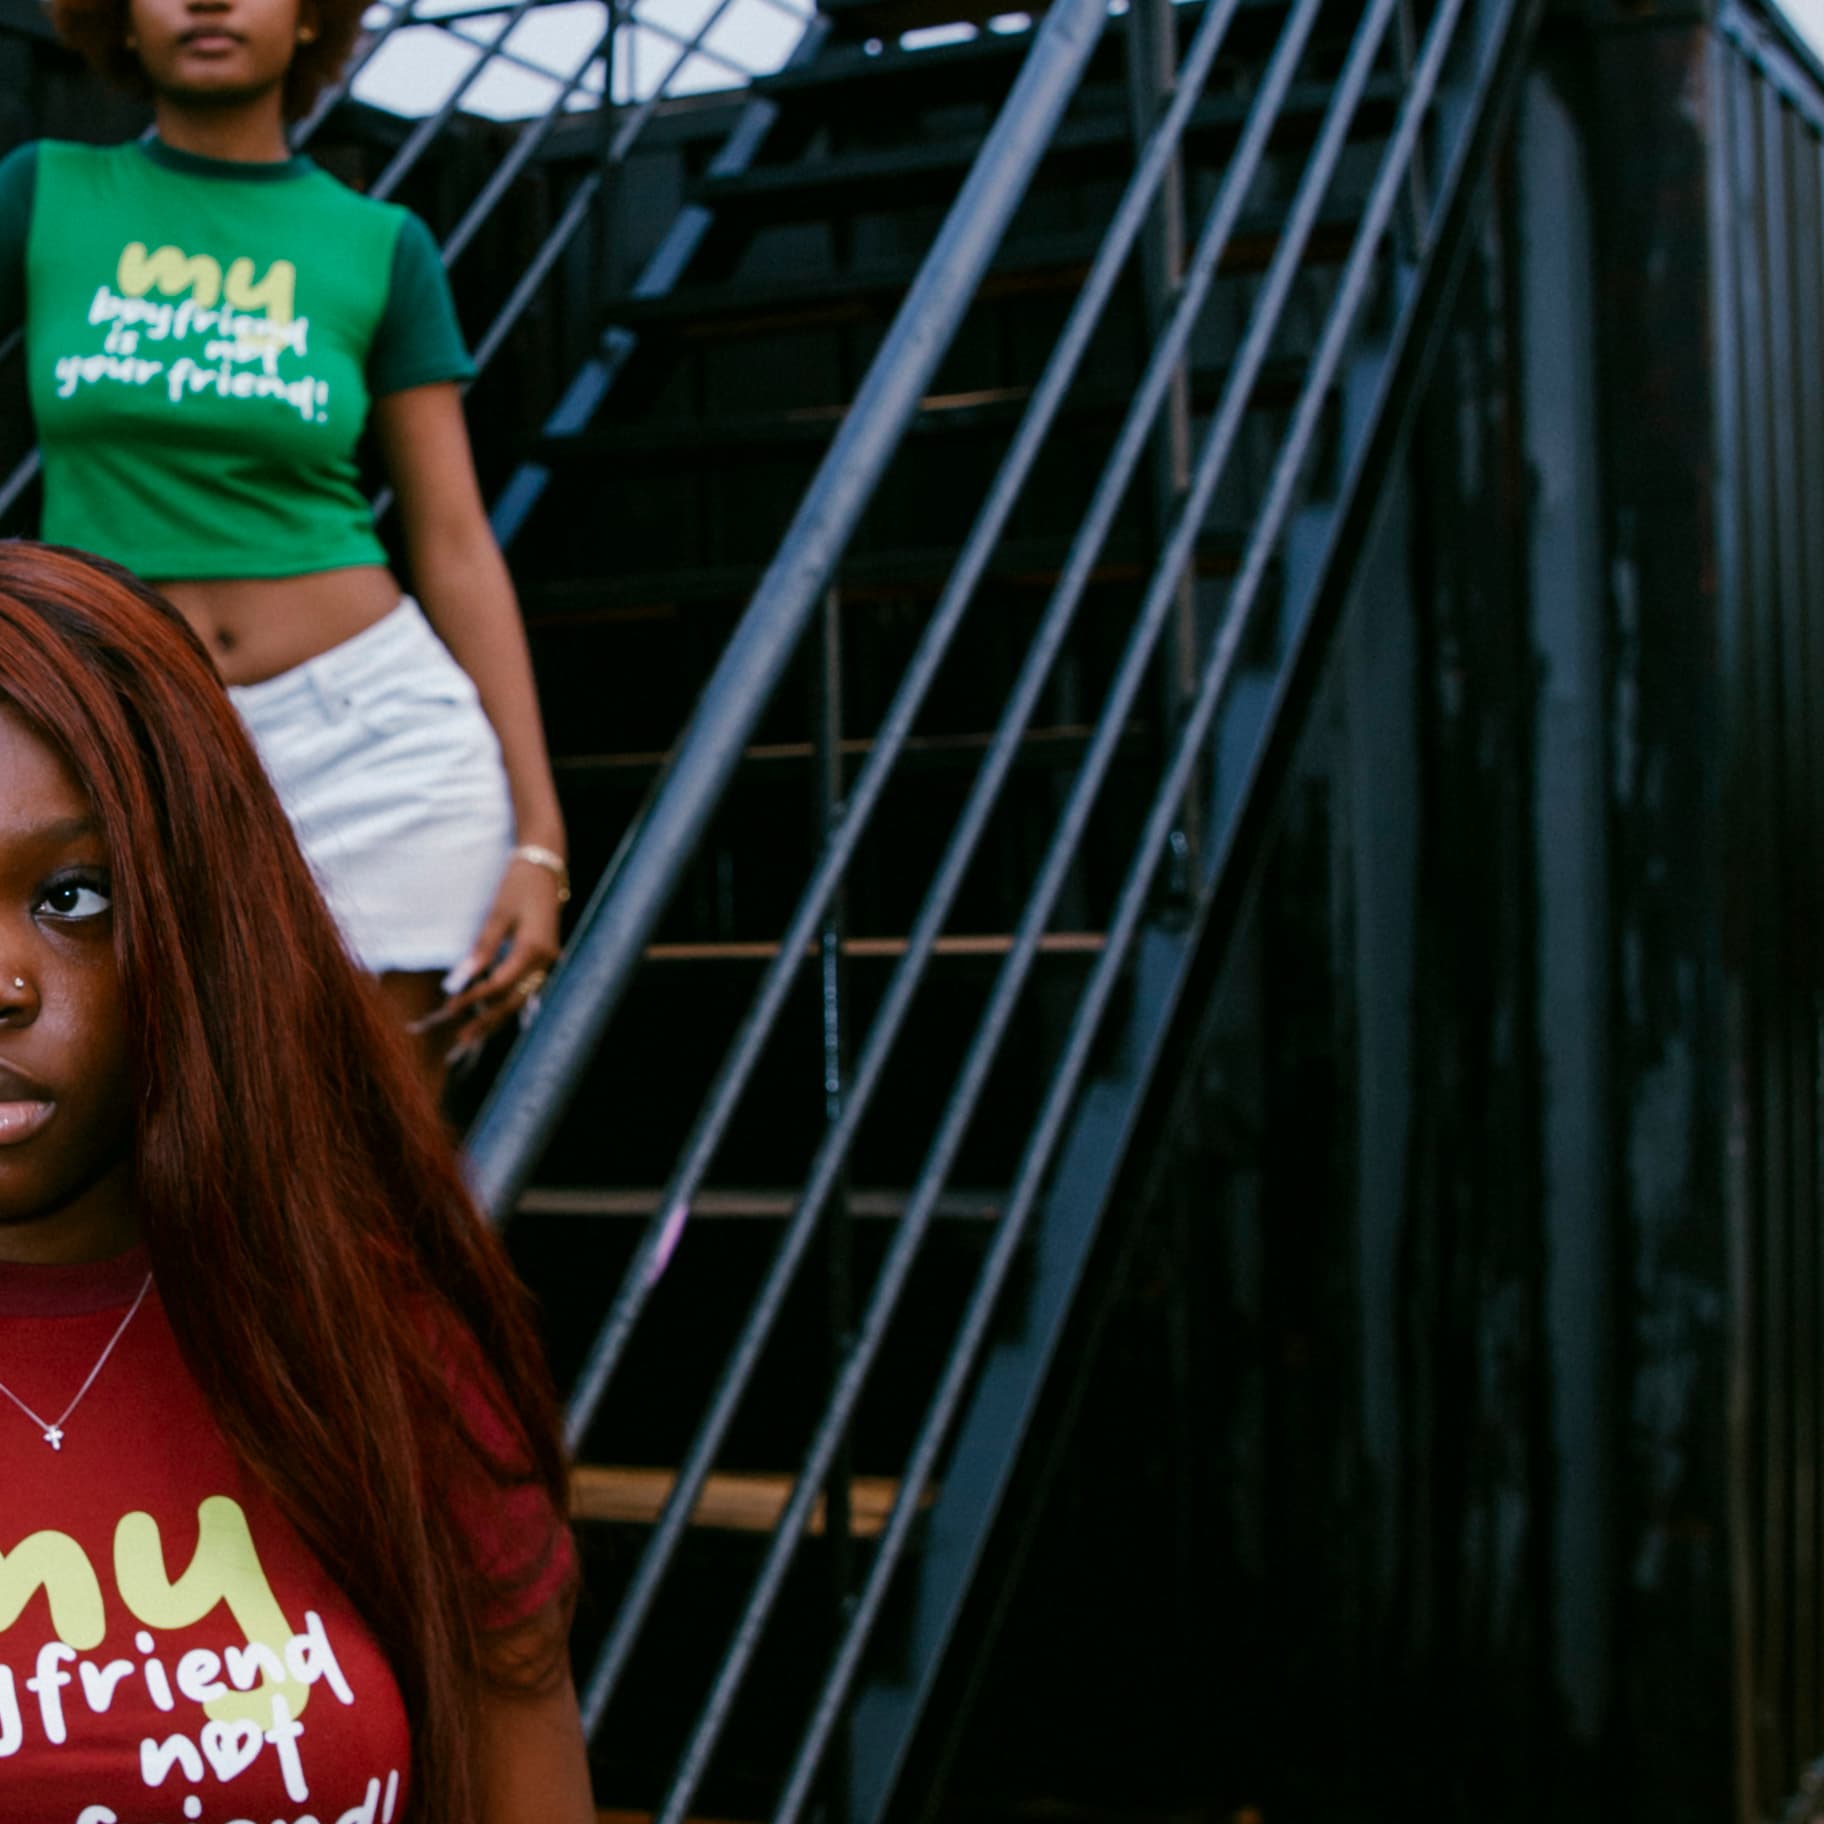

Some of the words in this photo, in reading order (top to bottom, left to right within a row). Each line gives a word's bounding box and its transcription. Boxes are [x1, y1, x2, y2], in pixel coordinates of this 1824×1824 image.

[88, 285, 309, 357] boyfriend
[117, 242, 295, 350] my
[104, 321, 139, 355] is
[205, 340, 277, 376] not
[55, 354, 162, 398] your
[168, 357, 328, 423] friend!
[140, 1694, 309, 1803] not
